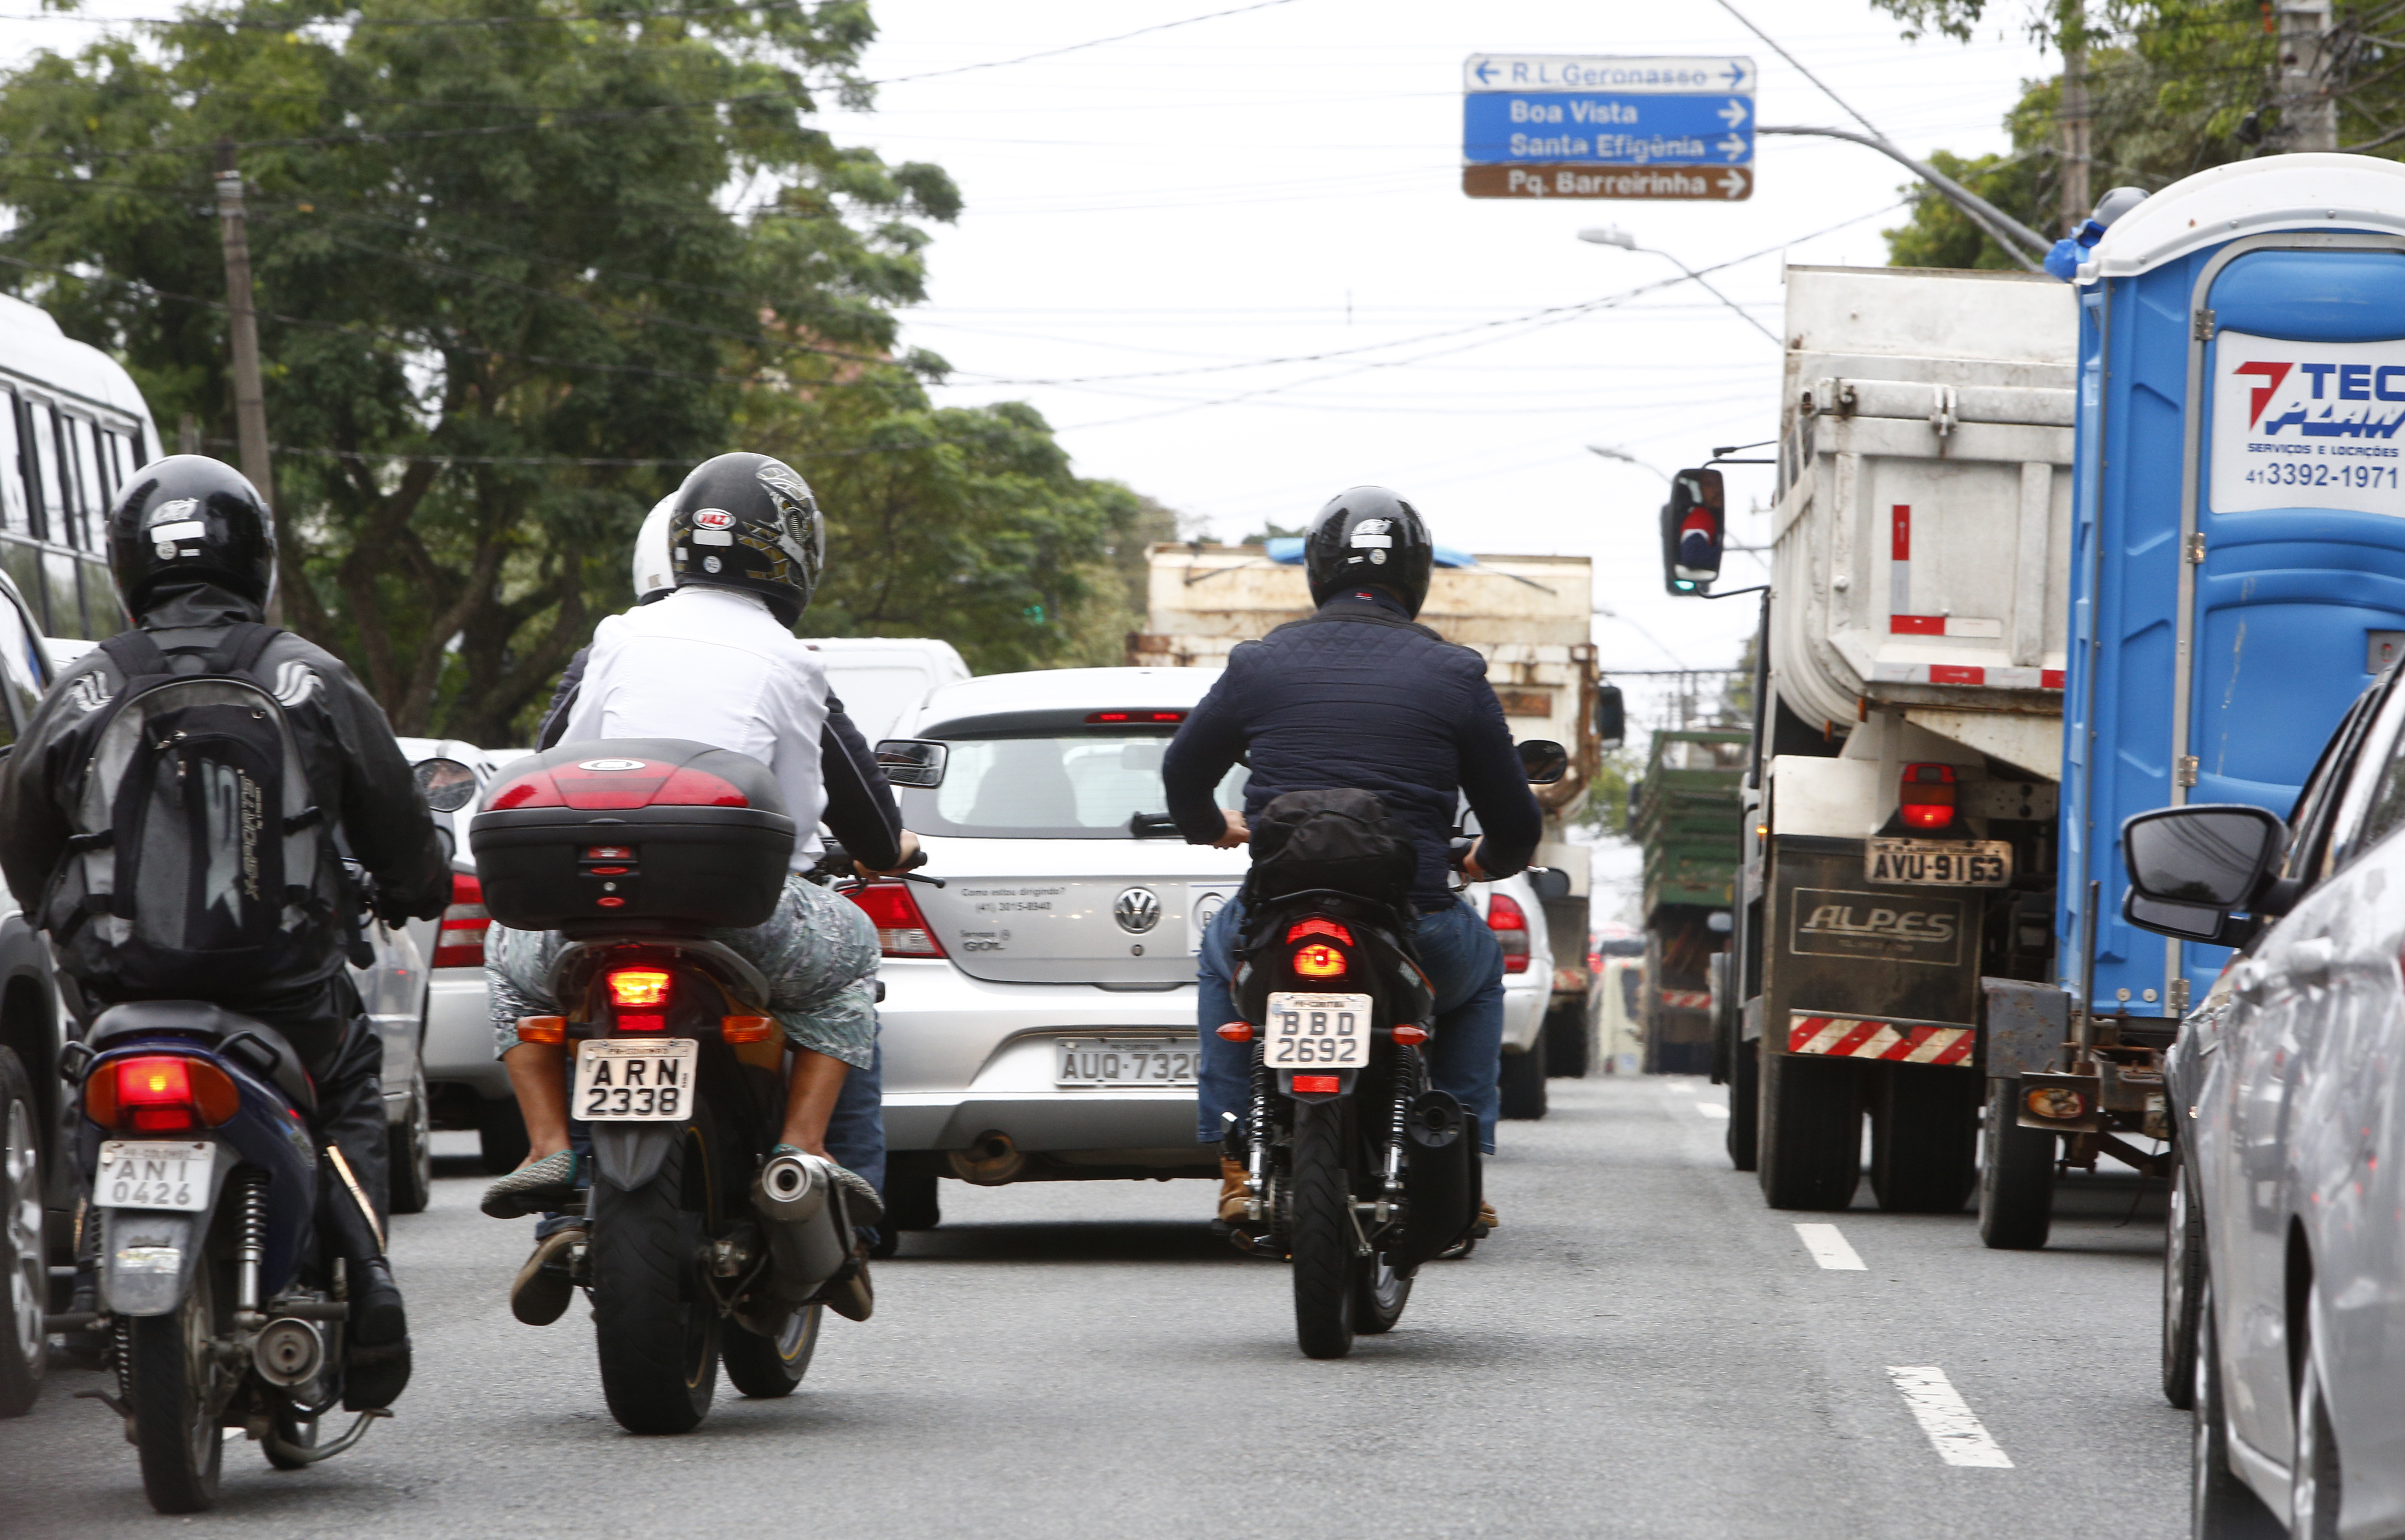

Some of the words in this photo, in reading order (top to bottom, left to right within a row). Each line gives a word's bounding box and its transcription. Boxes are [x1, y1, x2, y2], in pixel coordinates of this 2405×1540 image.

[1510, 100, 1562, 123] Boa
[1570, 101, 1637, 124] Vista
[1510, 133, 1588, 157] Santa
[1508, 170, 1549, 196] Pq.
[1556, 171, 1706, 195] Barreirinha
[2248, 443, 2311, 456] SERVIÇOS
[2318, 445, 2326, 454] E
[2331, 445, 2399, 459] LOCAÇÕES
[1874, 854, 2003, 881] AVU-9163
[1019, 887, 1066, 897] dirigindo?
[1803, 905, 1955, 941] ALPES
[963, 939, 1006, 951] GOL
[1283, 1012, 1354, 1036] BBD
[1277, 1038, 1356, 1062] 2692
[594, 1059, 678, 1086] ARN
[586, 1088, 678, 1116] 2338
[116, 1160, 186, 1181] ANI
[112, 1181, 191, 1205] 0426
